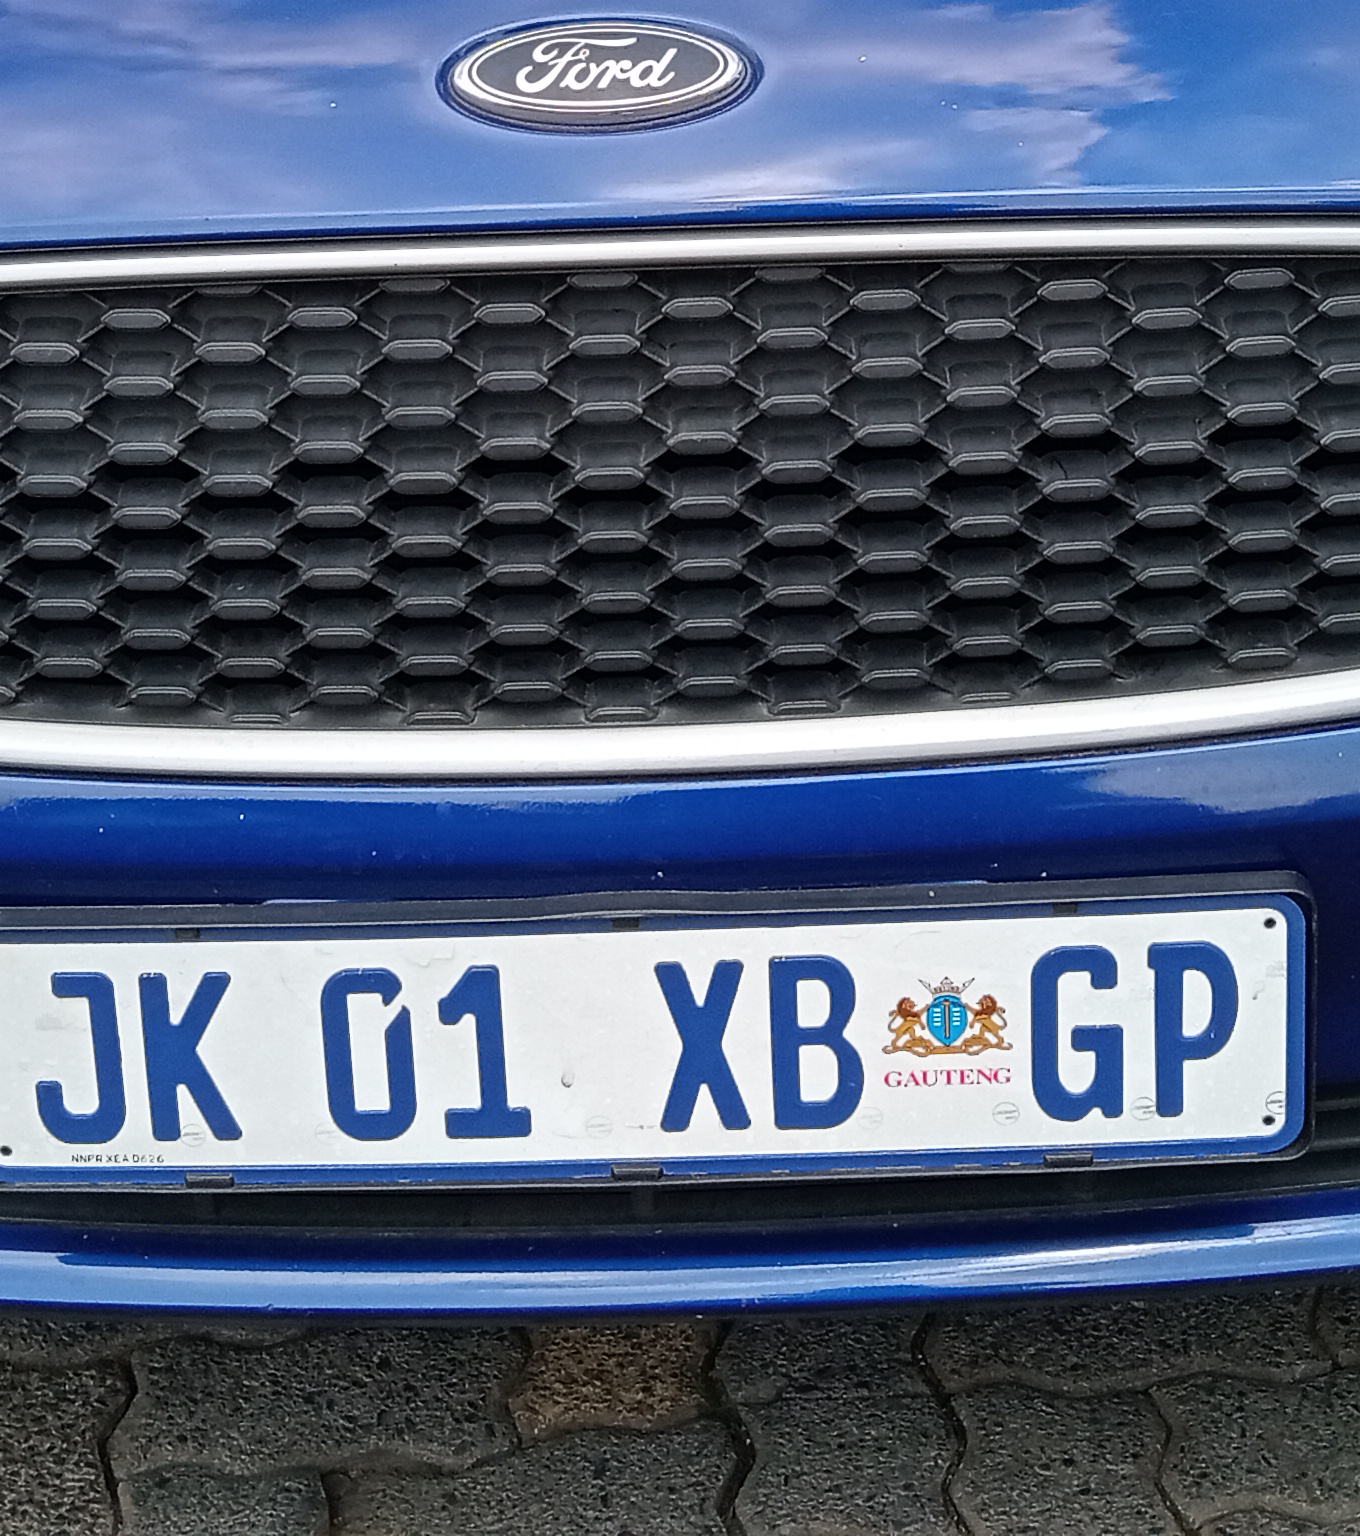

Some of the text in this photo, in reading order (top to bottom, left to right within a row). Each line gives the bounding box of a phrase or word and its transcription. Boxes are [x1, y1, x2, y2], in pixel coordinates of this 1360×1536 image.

[515, 37, 678, 93] Ford
[35, 940, 1239, 1145] JK 01 XB GP
[883, 1067, 1012, 1088] GAUTENG
